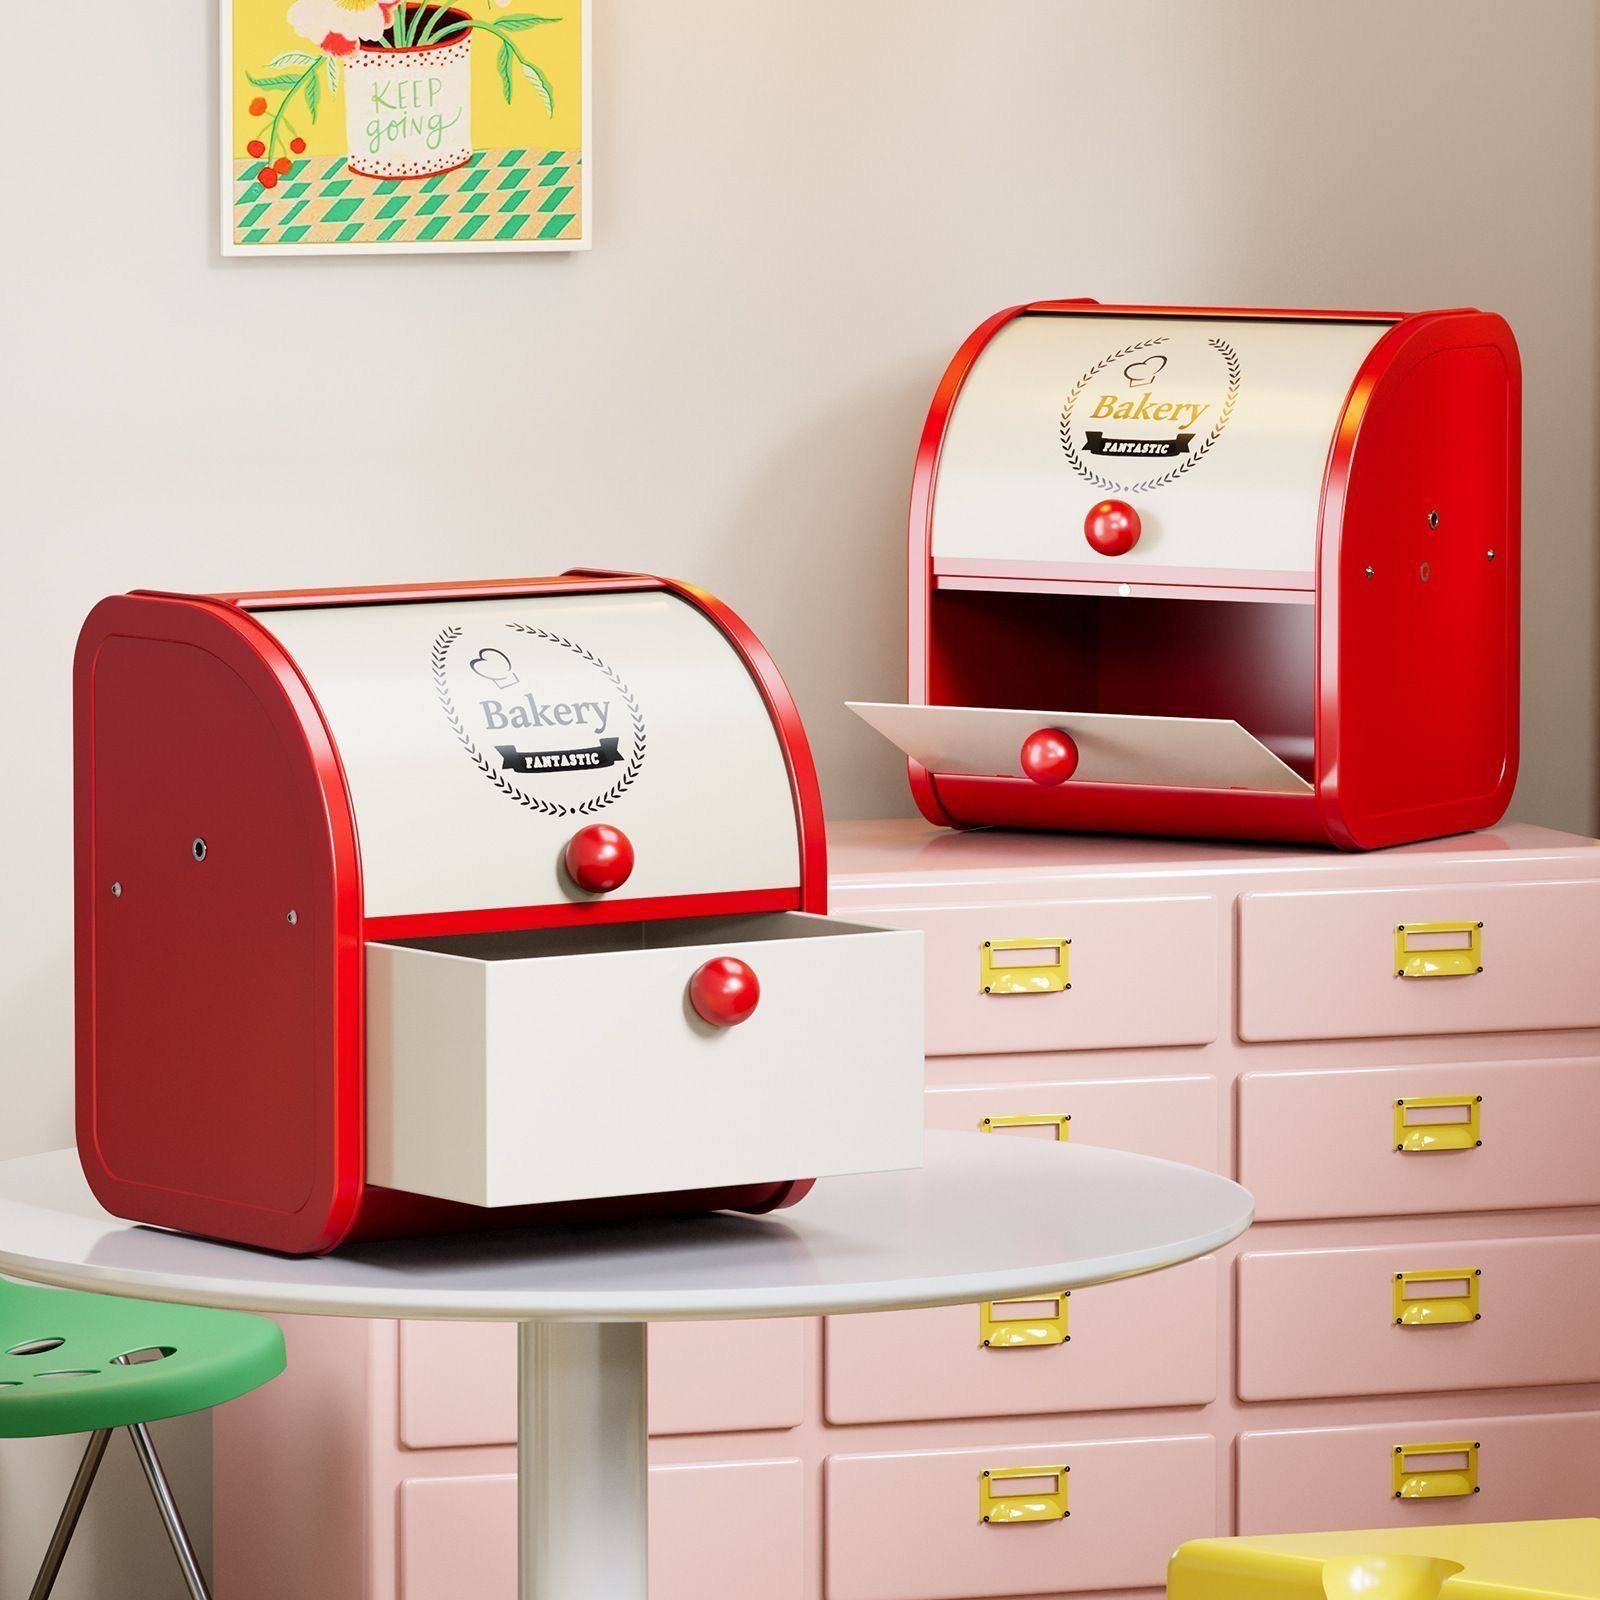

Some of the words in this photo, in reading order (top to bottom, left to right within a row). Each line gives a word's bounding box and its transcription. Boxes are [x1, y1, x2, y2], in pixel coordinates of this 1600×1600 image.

[371, 77, 443, 113] KEEP
[1089, 392, 1211, 430] Bakery
[1102, 442, 1170, 455] FANTASTIC
[479, 693, 611, 734] Bakery
[524, 752, 601, 769] FANTASTIC
